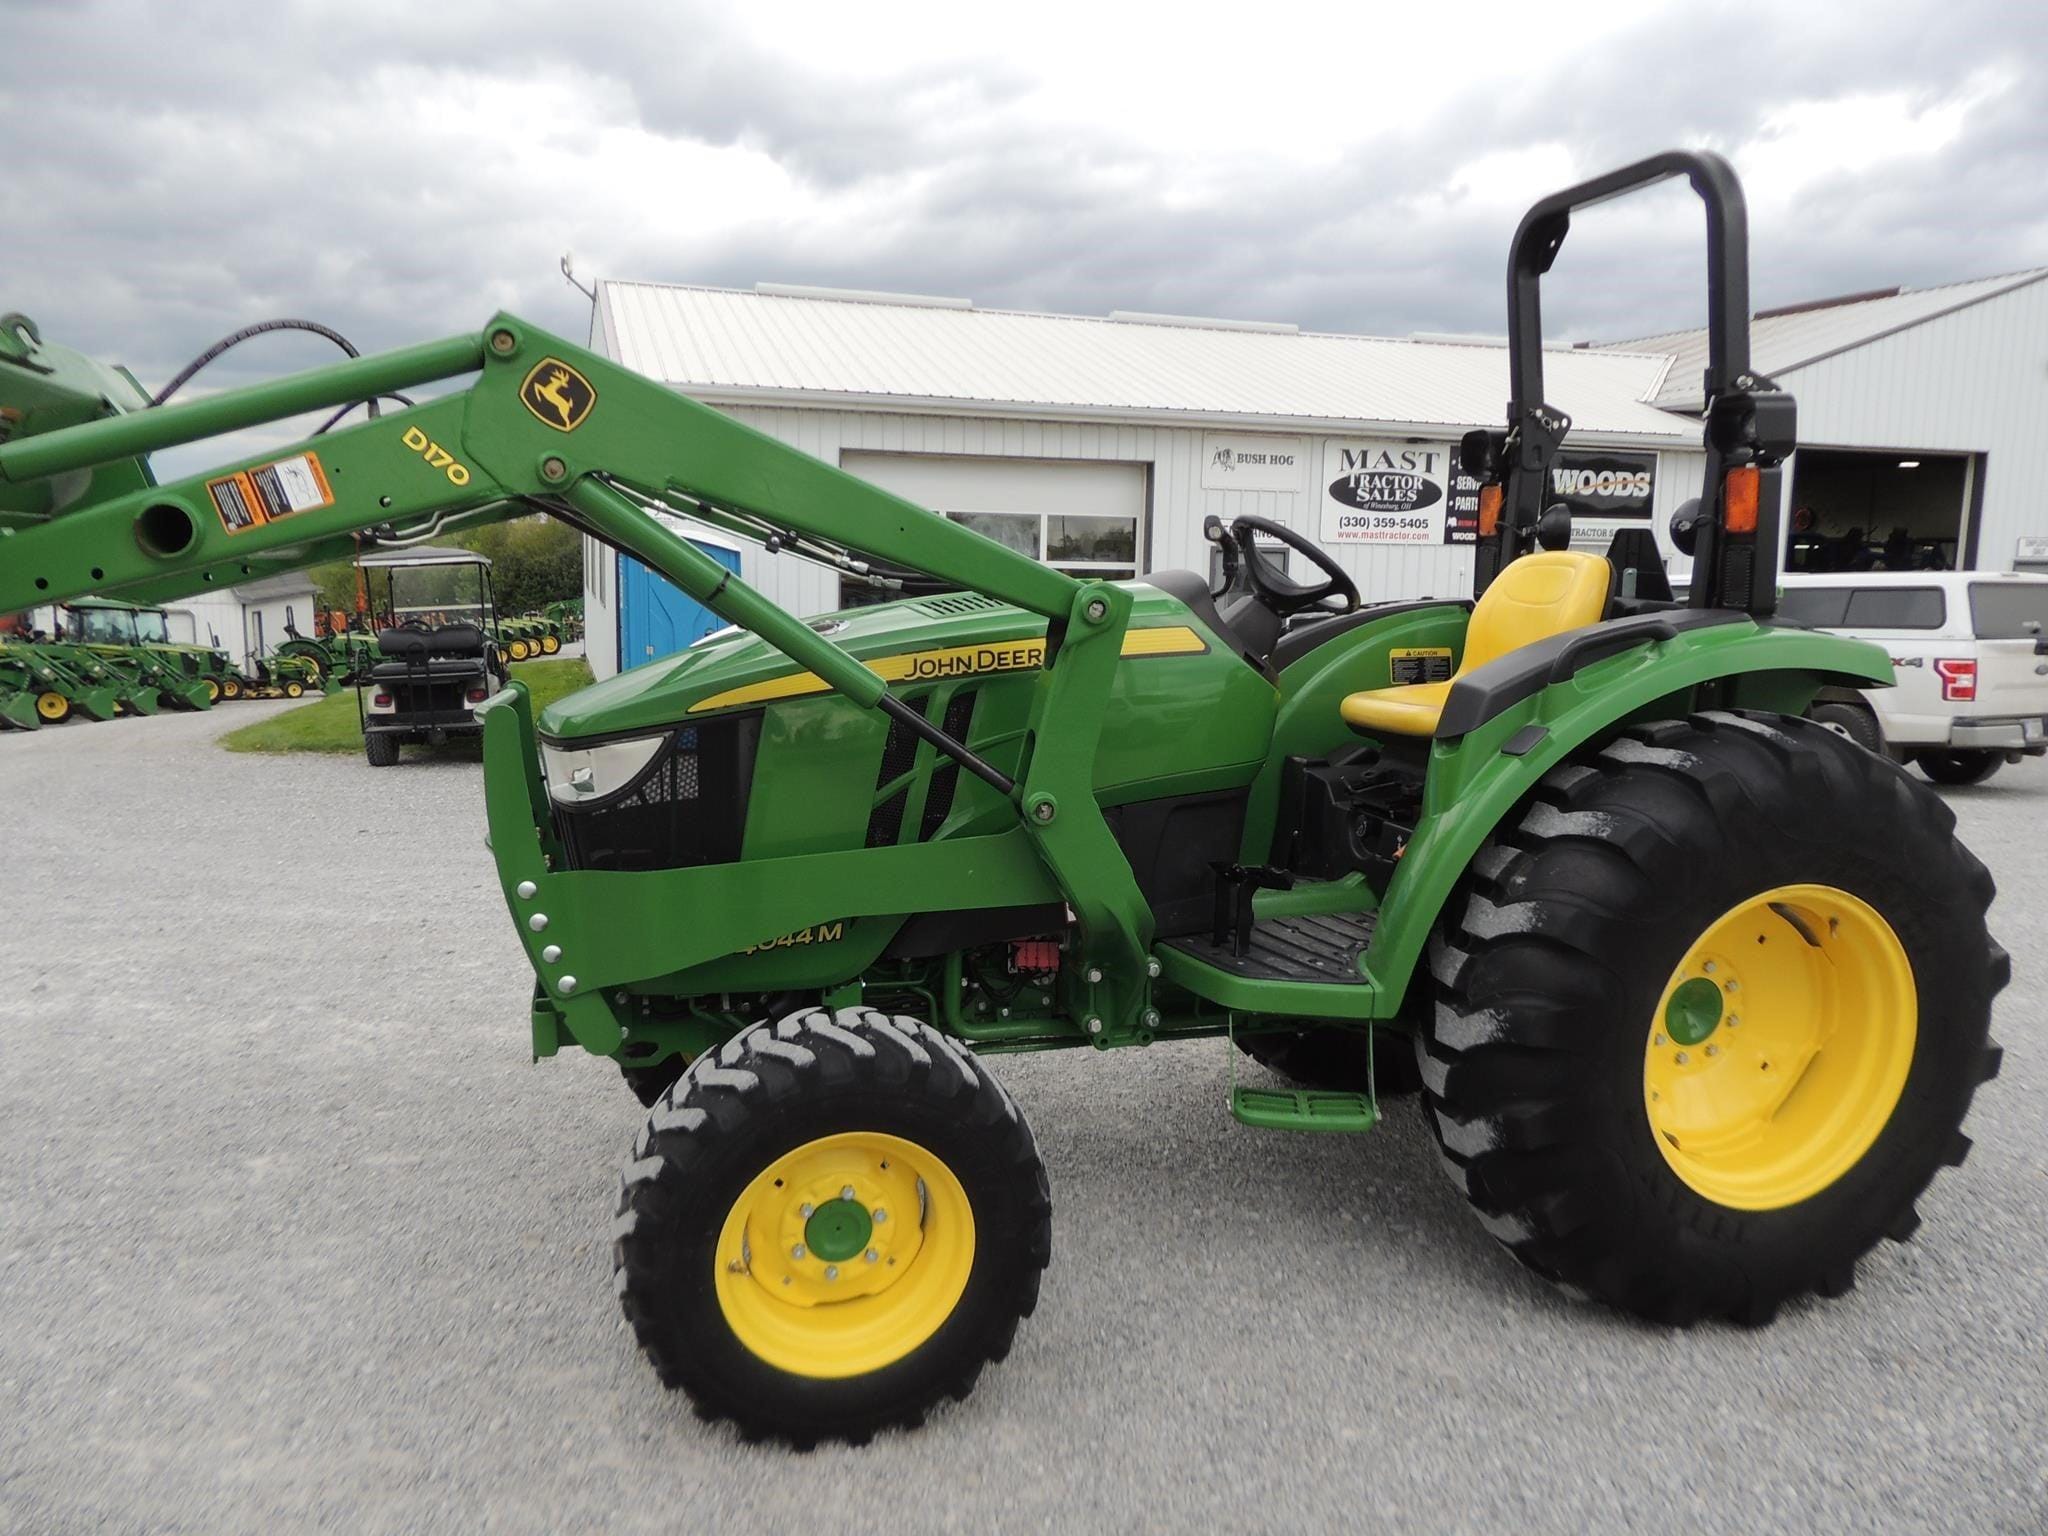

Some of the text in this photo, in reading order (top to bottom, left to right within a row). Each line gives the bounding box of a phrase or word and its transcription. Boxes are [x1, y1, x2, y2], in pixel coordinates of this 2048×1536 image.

[402, 426, 470, 486] D170
[1237, 453, 1294, 466] BUSH HOG
[1339, 448, 1440, 474] MAST
[1348, 472, 1424, 490] TRACTOR
[1552, 469, 1650, 497] WOODS
[1356, 488, 1418, 502] SALES
[1339, 516, 1429, 530] (330) 359-5405
[1337, 531, 1430, 540] www.masttractor.com
[1571, 528, 1607, 537] TRACTOR
[904, 648, 1042, 678] JOHN DEER
